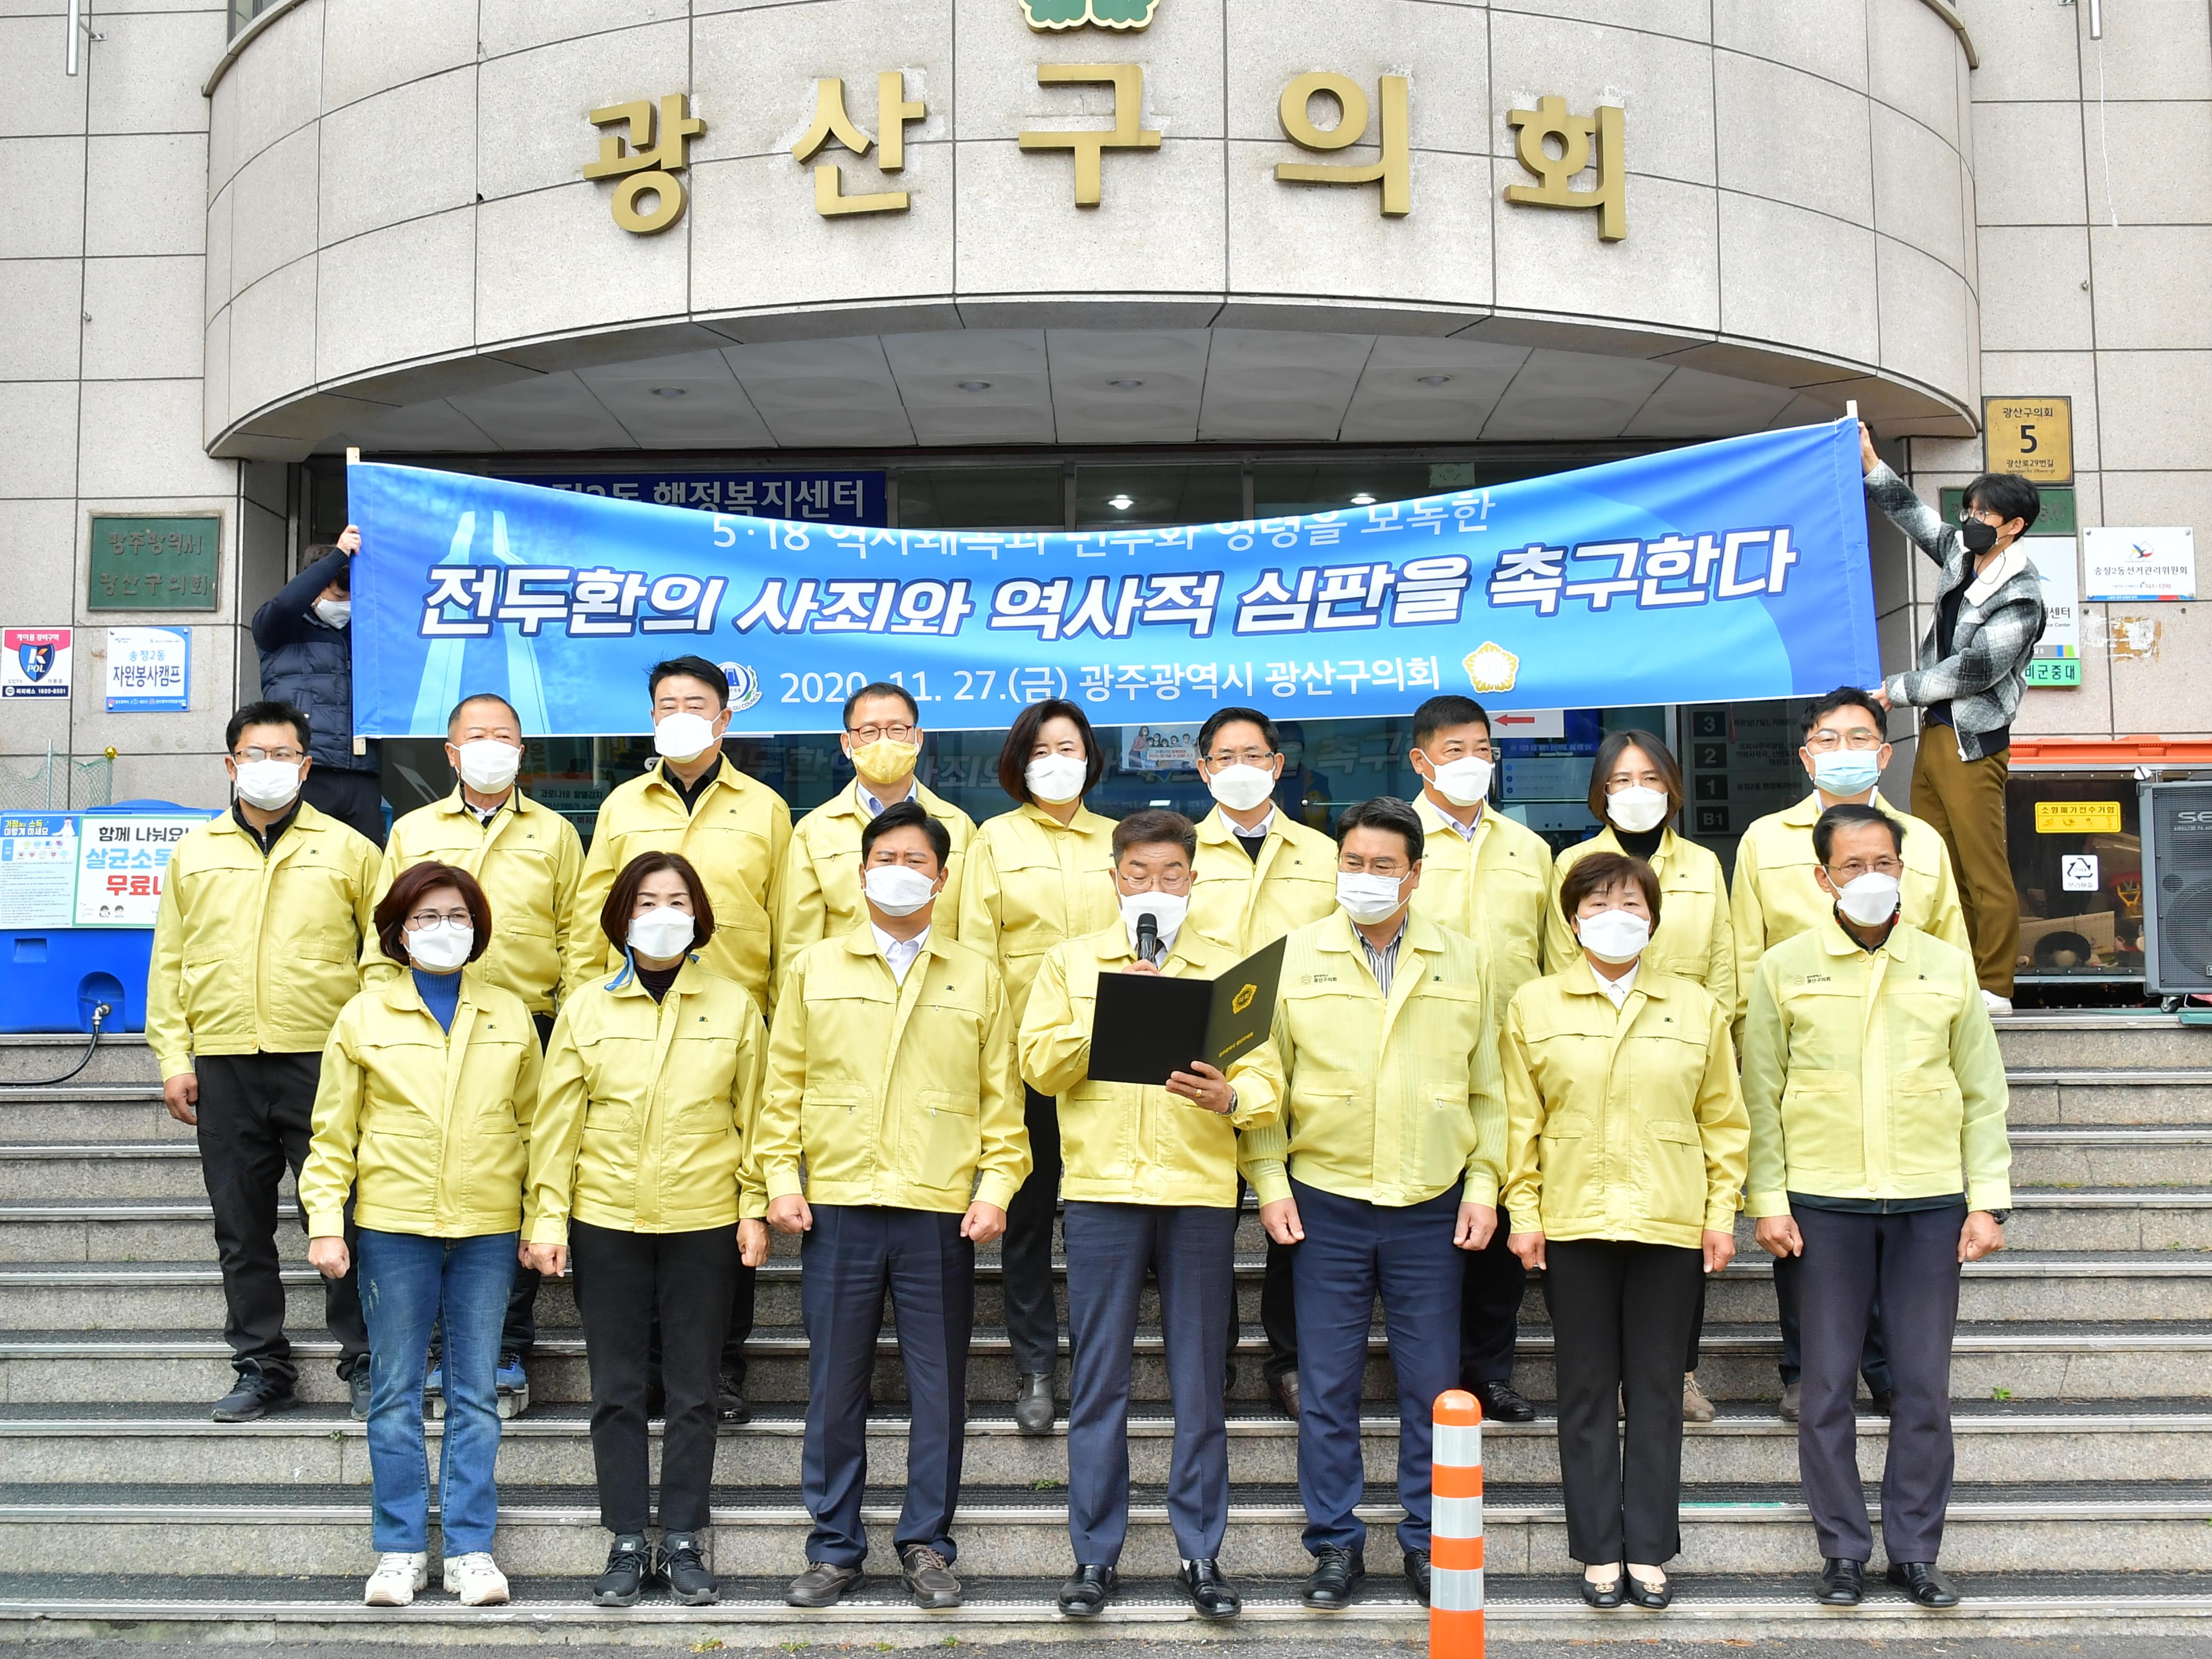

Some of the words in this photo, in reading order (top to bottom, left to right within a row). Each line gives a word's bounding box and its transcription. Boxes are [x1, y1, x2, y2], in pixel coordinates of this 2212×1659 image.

[583, 64, 1626, 242] 광산구의회
[2002, 407, 2054, 418] 광산구의회
[2020, 425, 2037, 454] 5
[2006, 459, 2054, 468] 광산로29번길
[653, 479, 864, 518] 행정복지센터
[1360, 490, 1496, 535] 모독한
[108, 532, 202, 556] 광주광역시
[2094, 565, 2188, 576] 송정2동선거관리위원회
[99, 573, 208, 596] 광산구의회
[418, 564, 727, 638] 전두환의
[733, 577, 976, 637] 사죄와
[986, 571, 1224, 641] 역사적
[1233, 554, 1472, 637] 심판을
[1487, 524, 1801, 616] 촉구한다
[129, 650, 166, 662] 송정2동
[27, 664, 46, 673] POL
[113, 665, 181, 688] 자원봉사캠프
[2025, 664, 2075, 680] 비군중대
[1079, 661, 1253, 702] 광주광역시
[1264, 655, 1440, 696] 광산구의회
[1704, 716, 1715, 733] 3
[1705, 748, 1716, 764] 2
[1707, 779, 1715, 795] 1
[1704, 812, 1722, 826] B1
[99, 826, 130, 842] 함께
